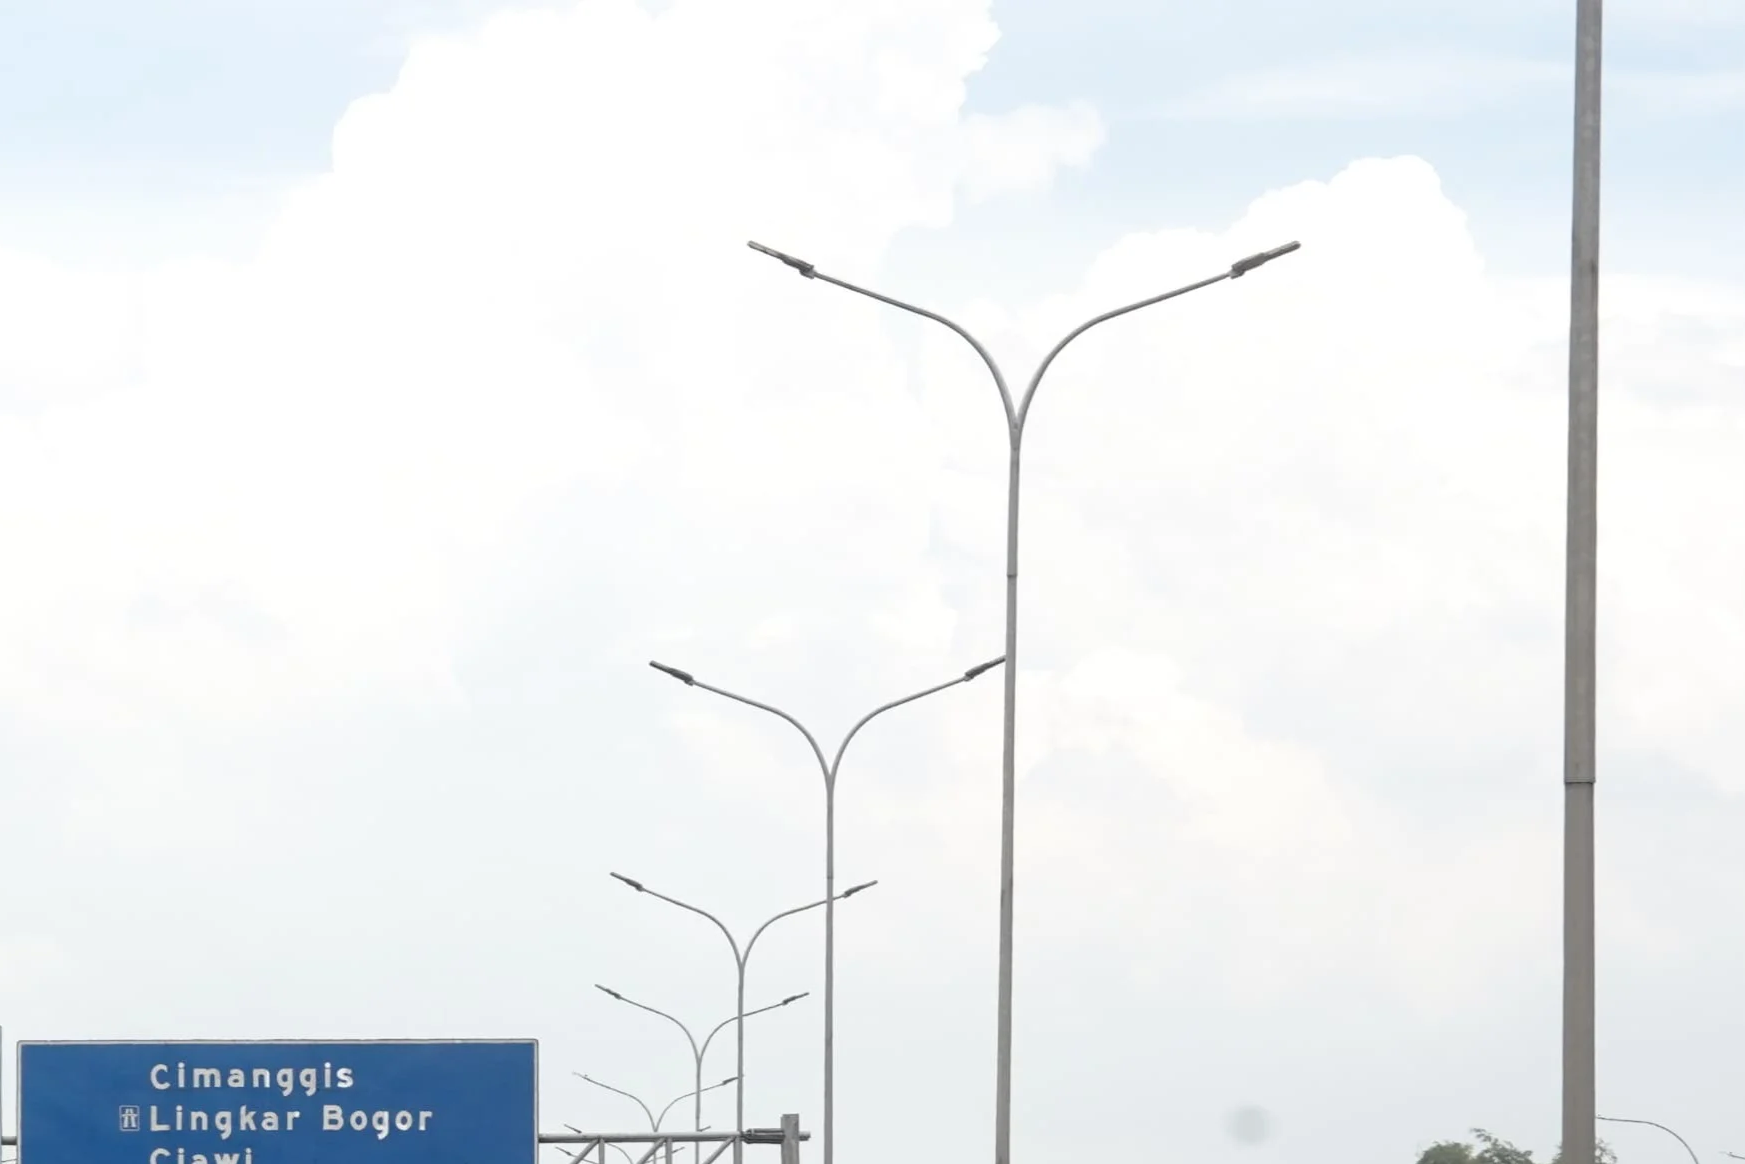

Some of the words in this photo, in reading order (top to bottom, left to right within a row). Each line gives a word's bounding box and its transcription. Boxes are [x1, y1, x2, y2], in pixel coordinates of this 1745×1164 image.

[150, 1061, 354, 1097] Cimanggis
[149, 1104, 301, 1140] Lingkar
[322, 1104, 433, 1140] Bogor
